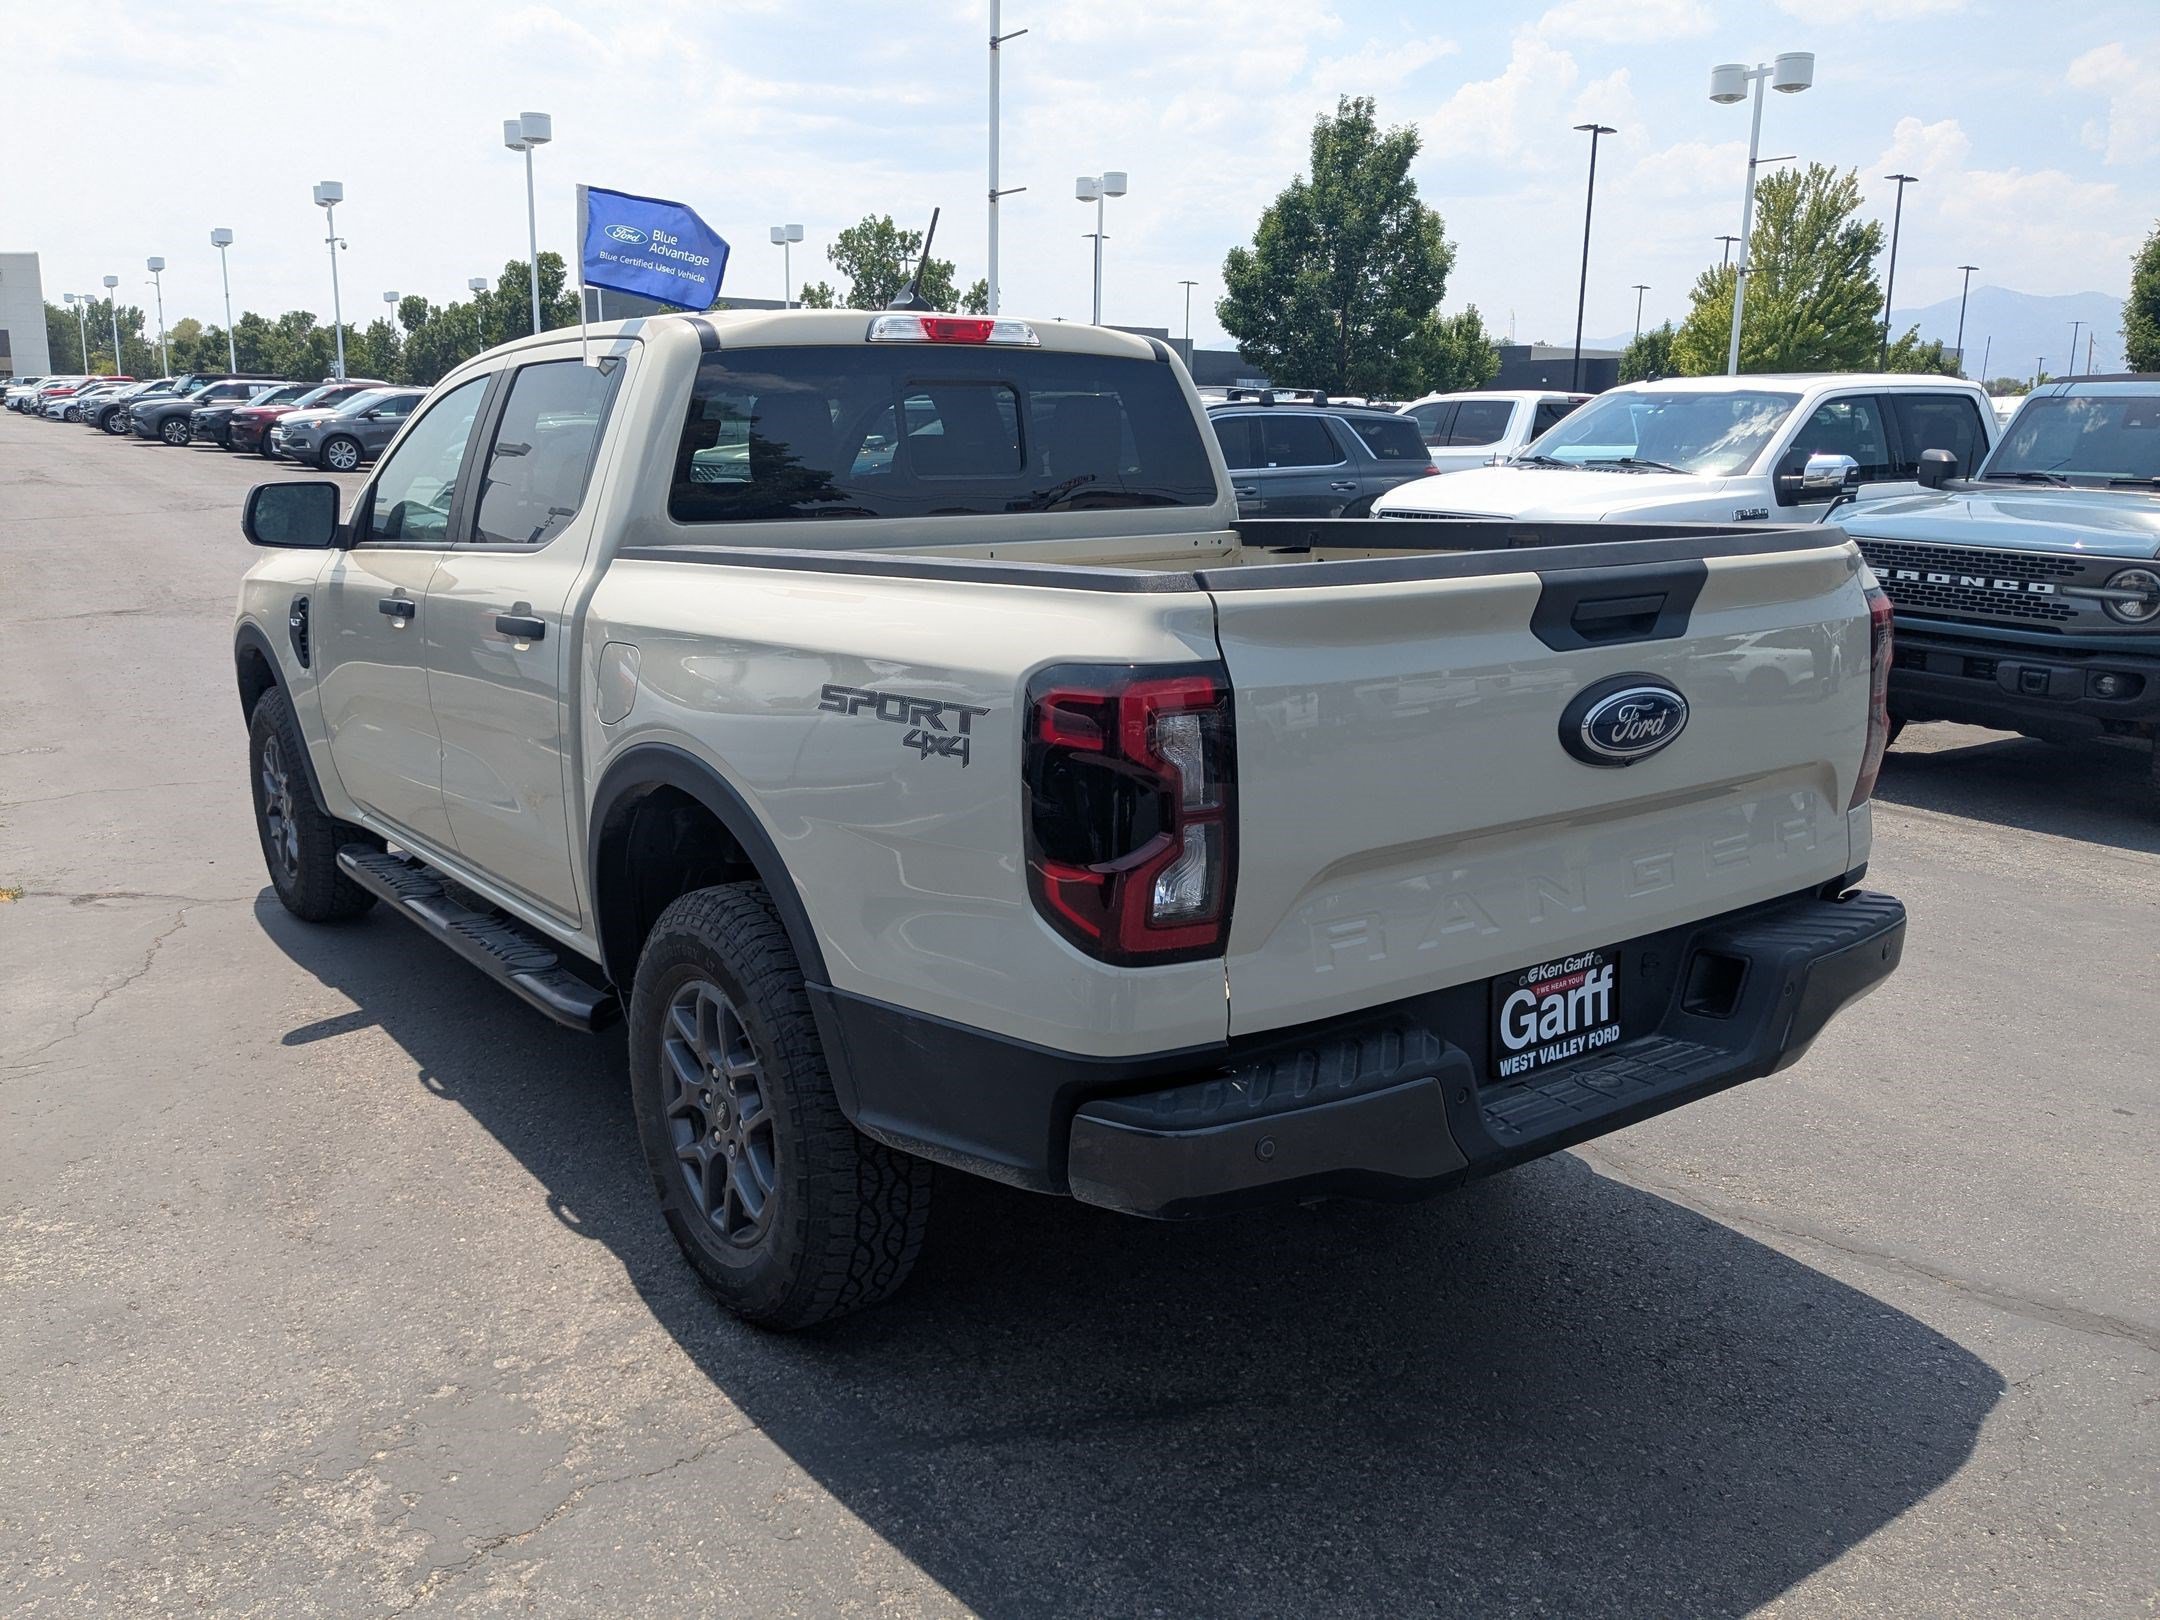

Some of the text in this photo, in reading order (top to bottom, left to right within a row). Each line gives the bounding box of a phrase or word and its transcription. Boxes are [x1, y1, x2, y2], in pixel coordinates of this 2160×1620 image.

[612, 226, 640, 243] Ford
[652, 230, 678, 246] Blue
[599, 251, 706, 284] Blue Certified Used Vehicle
[649, 242, 710, 266] Advantage
[1869, 567, 2055, 594] BRONCO
[818, 683, 992, 735] SPORT
[1611, 702, 1669, 743] Ford
[1310, 810, 1818, 974] RANGER
[1538, 951, 1595, 981] Ken Garff
[1540, 975, 1581, 994] WE HEAR YOU
[1500, 964, 1613, 1050] Garff
[1500, 1024, 1620, 1078] WEST VALLEY FORD
